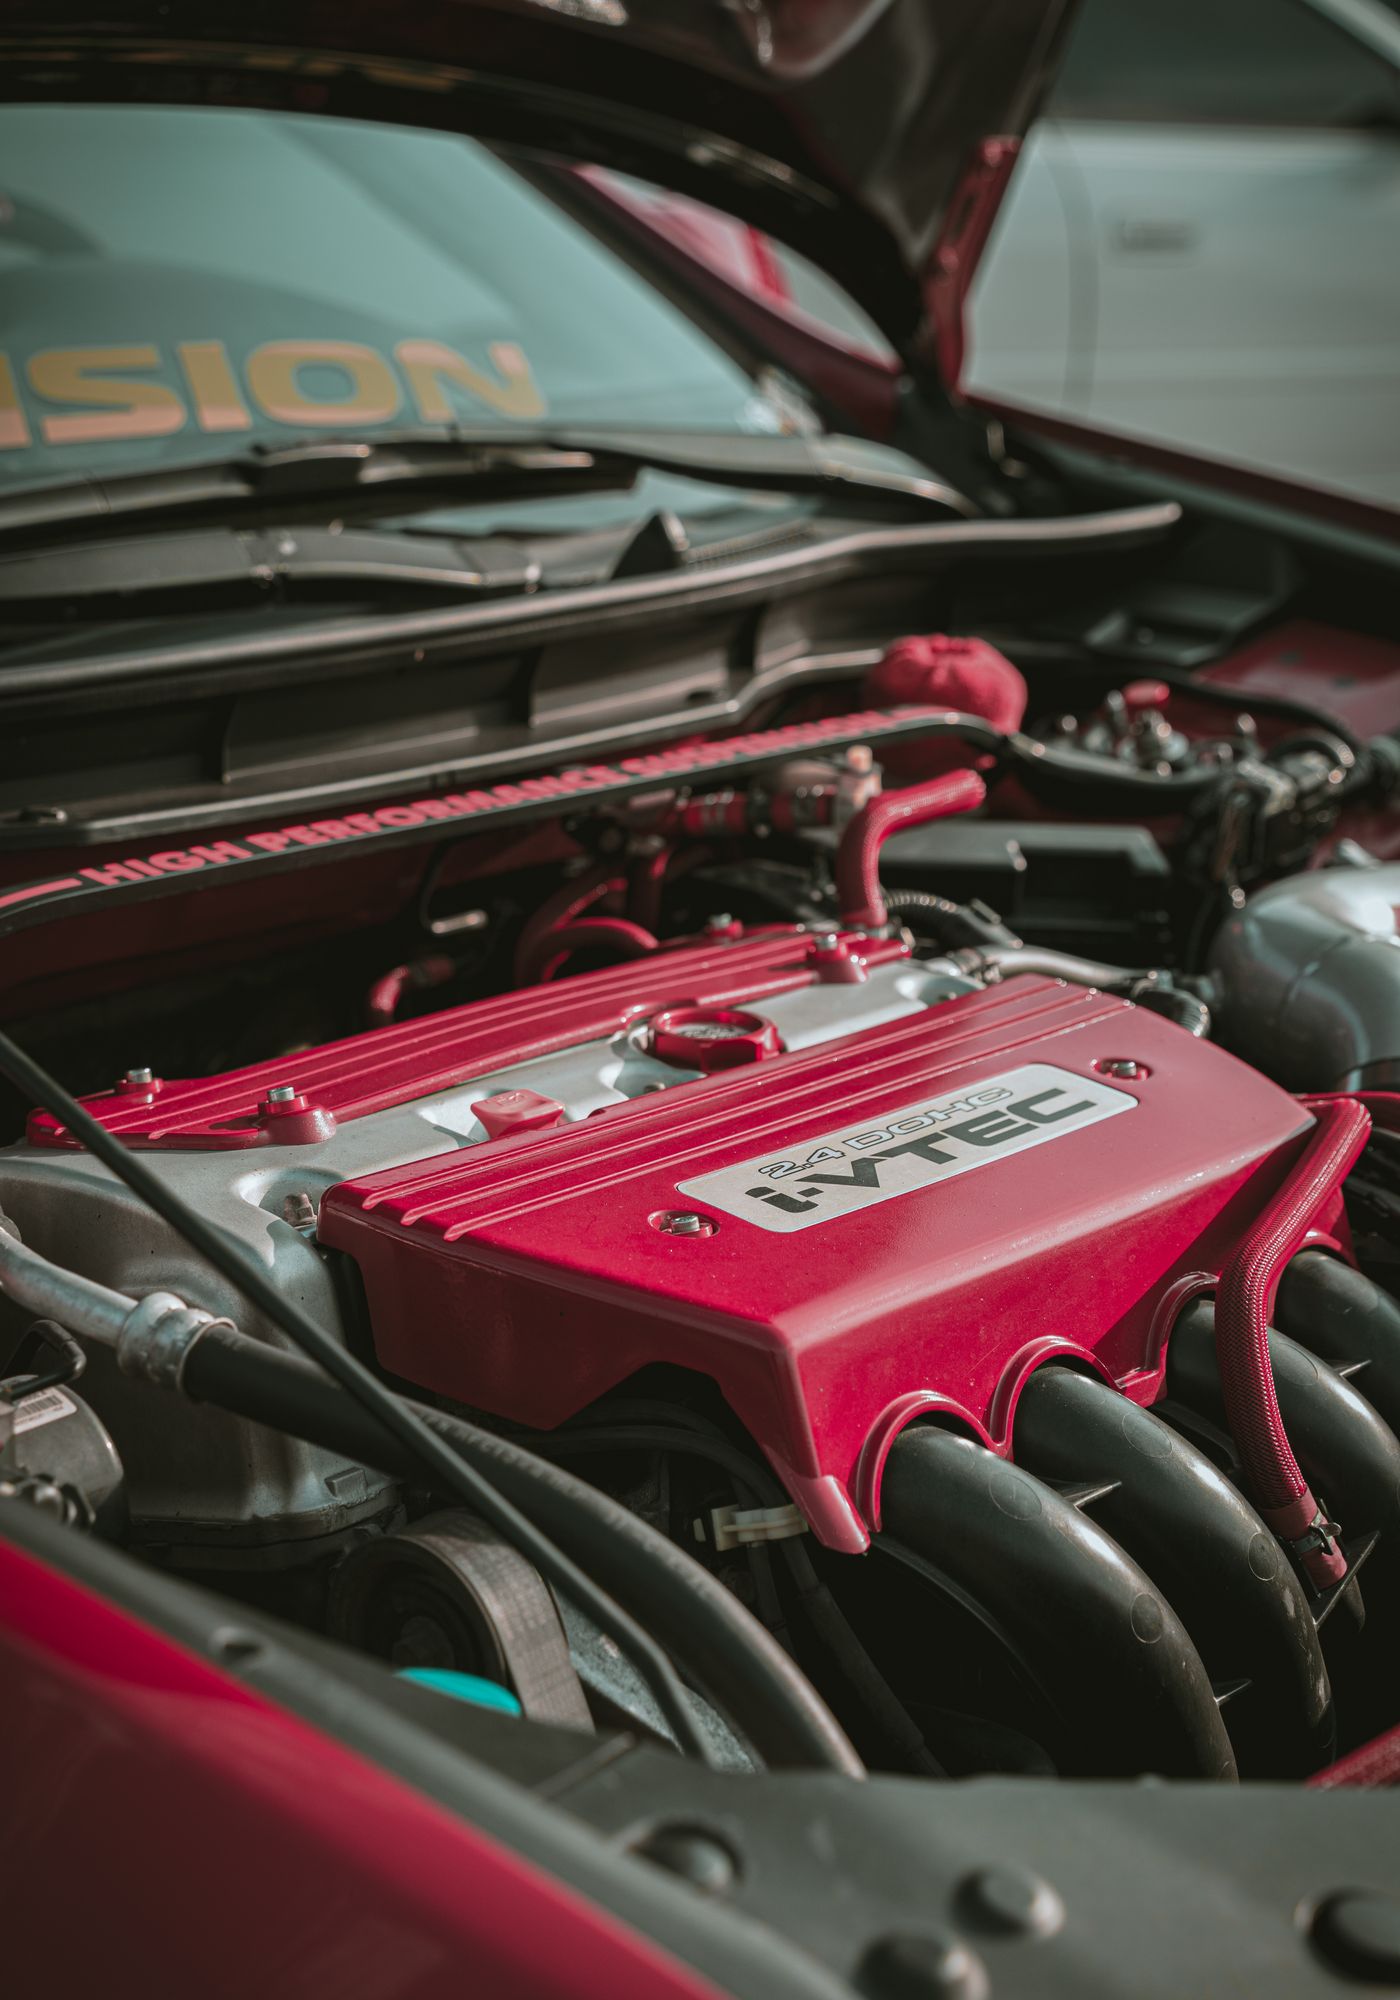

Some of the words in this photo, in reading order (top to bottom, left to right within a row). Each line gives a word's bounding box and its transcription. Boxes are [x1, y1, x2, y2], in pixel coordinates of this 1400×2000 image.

[79, 840, 254, 886] HIGH
[245, 764, 631, 853] PERFORMANCE
[758, 1145, 846, 1180] 2.4
[842, 1086, 1014, 1150] DOHC
